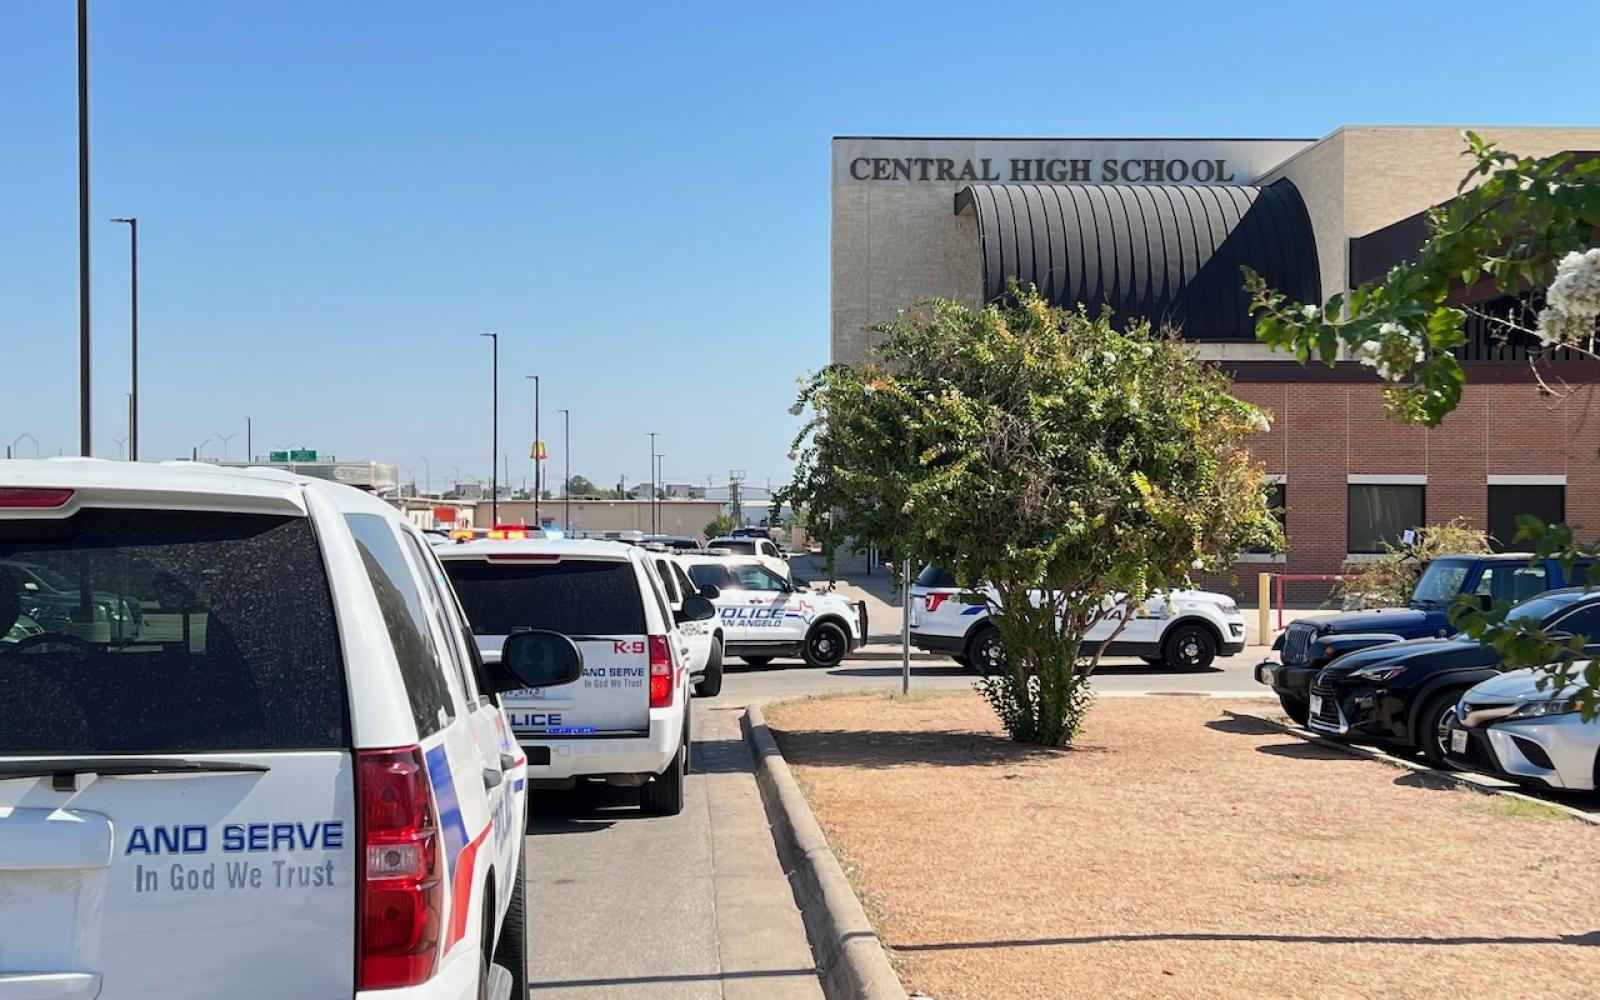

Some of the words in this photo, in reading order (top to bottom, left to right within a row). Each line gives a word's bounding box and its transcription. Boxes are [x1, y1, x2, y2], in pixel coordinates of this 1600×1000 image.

[849, 157, 1000, 182] CENTRAL
[1009, 159, 1092, 182] HIGH
[1101, 158, 1235, 183] SCHOOL
[718, 608, 784, 619] OLICE
[737, 619, 782, 627] ANGELO
[582, 667, 606, 677] AND
[609, 667, 645, 677] SERVE
[584, 679, 592, 688] In
[594, 679, 608, 688] God
[610, 679, 622, 688] We
[624, 678, 642, 688] Trust
[511, 713, 562, 726] LICE
[125, 824, 208, 856] AND
[222, 820, 344, 852] SERVE
[136, 864, 158, 892] In
[170, 863, 215, 891] God
[226, 862, 262, 889] We
[272, 860, 334, 887] Trust
